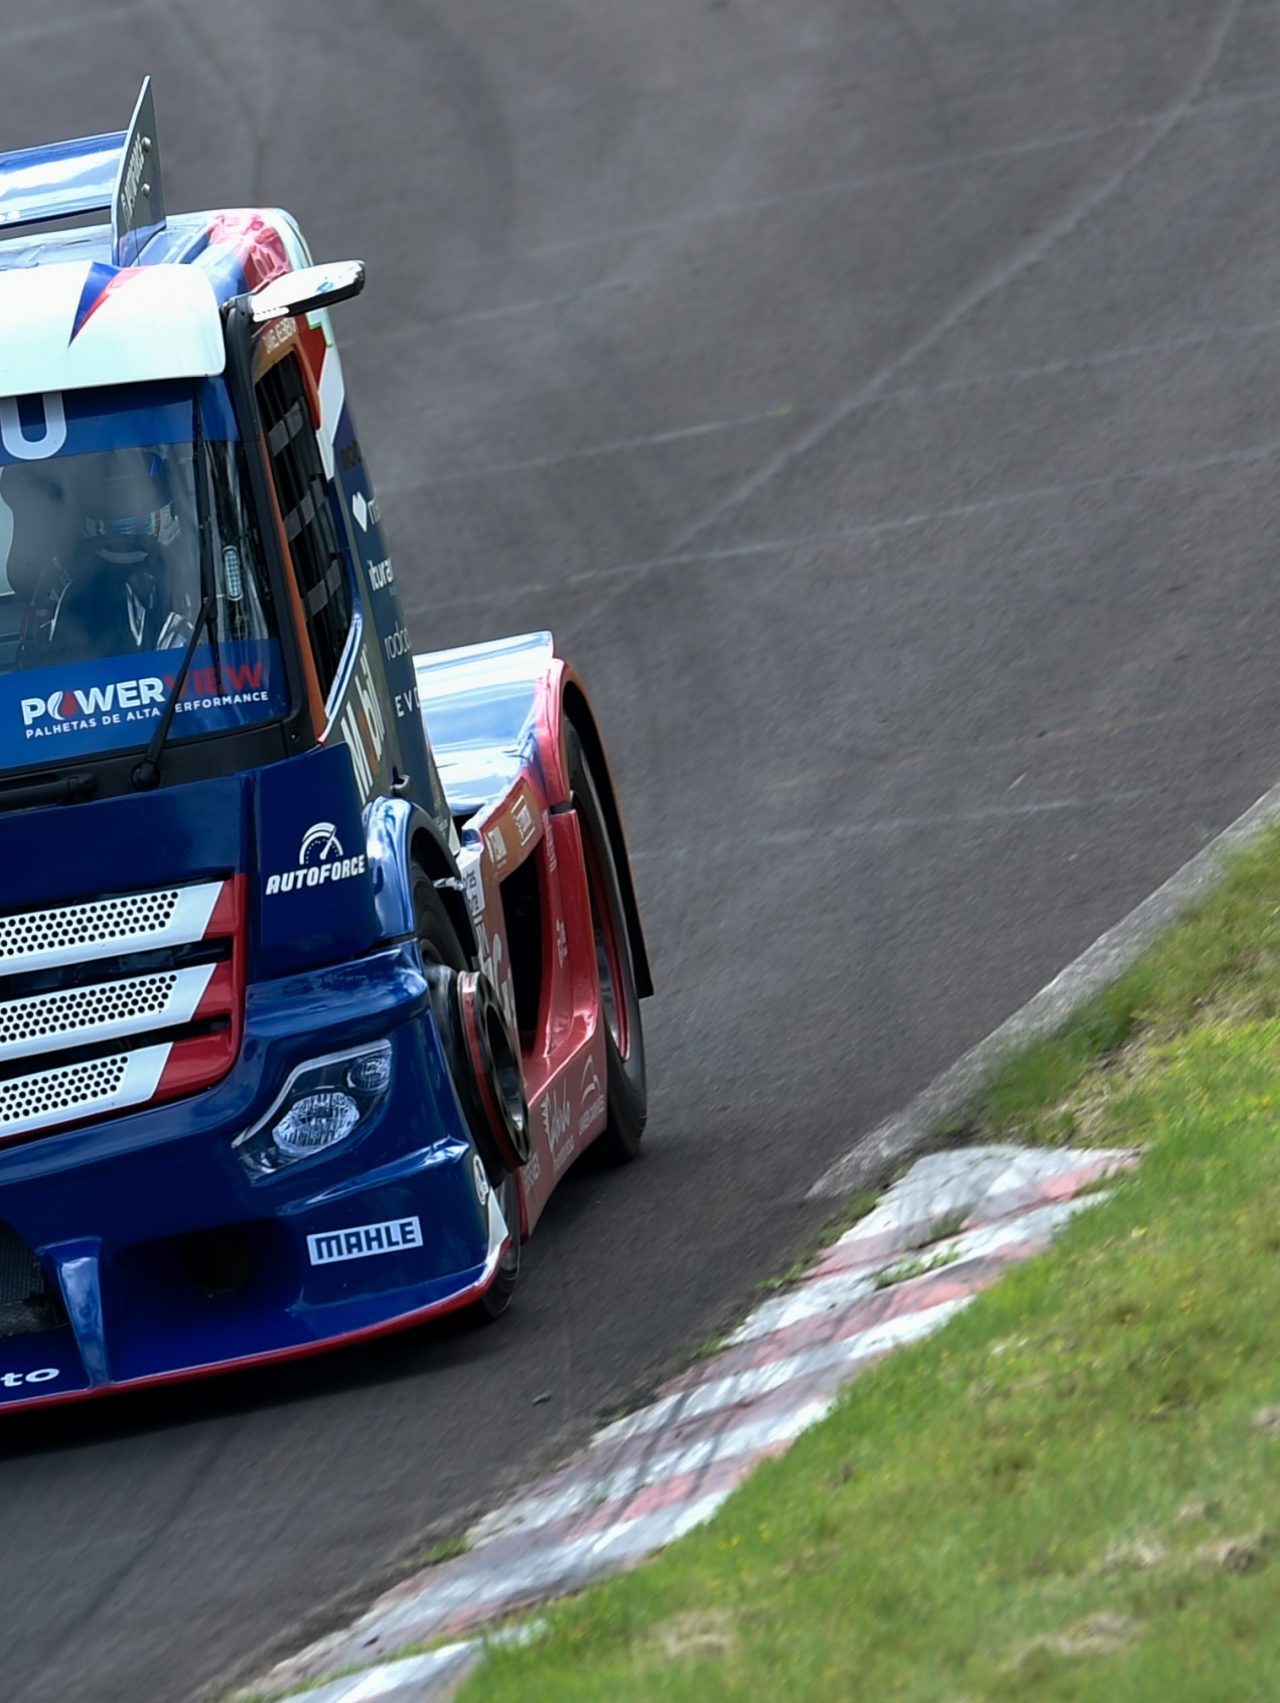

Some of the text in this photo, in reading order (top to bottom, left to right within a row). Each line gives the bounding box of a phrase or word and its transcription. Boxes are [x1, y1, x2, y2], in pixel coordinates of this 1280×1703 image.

[25, 691, 269, 739] PALHETAS DE ALTA ERFORMANCE
[265, 854, 366, 895] AUTOFORCE
[314, 1220, 417, 1260] MAHLE
